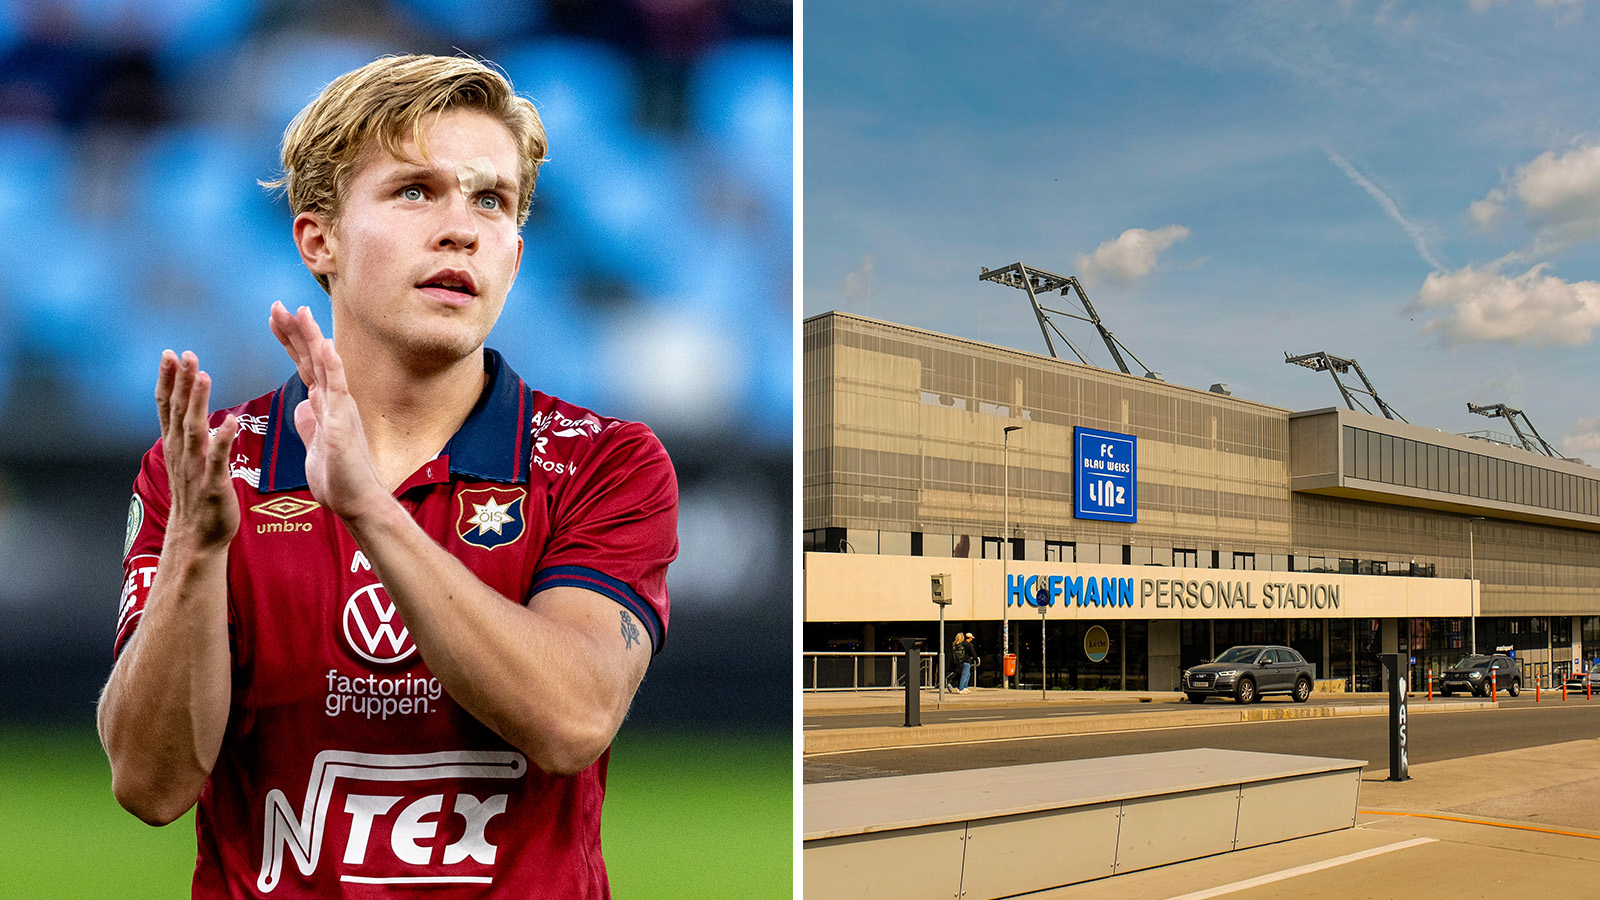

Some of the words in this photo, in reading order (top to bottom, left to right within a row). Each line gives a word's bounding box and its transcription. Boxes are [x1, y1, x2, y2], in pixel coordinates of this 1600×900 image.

[1100, 443, 1114, 458] FC
[1084, 457, 1105, 470] BLAU
[1106, 461, 1130, 473] WEISS
[1089, 479, 1126, 508] LINZ
[479, 508, 503, 522] ÖIS
[256, 521, 313, 535] umbro
[1140, 578, 1257, 609] PERSONAL
[1262, 582, 1341, 610] STADION
[325, 669, 442, 700] factoring
[325, 692, 429, 721] gruppen
